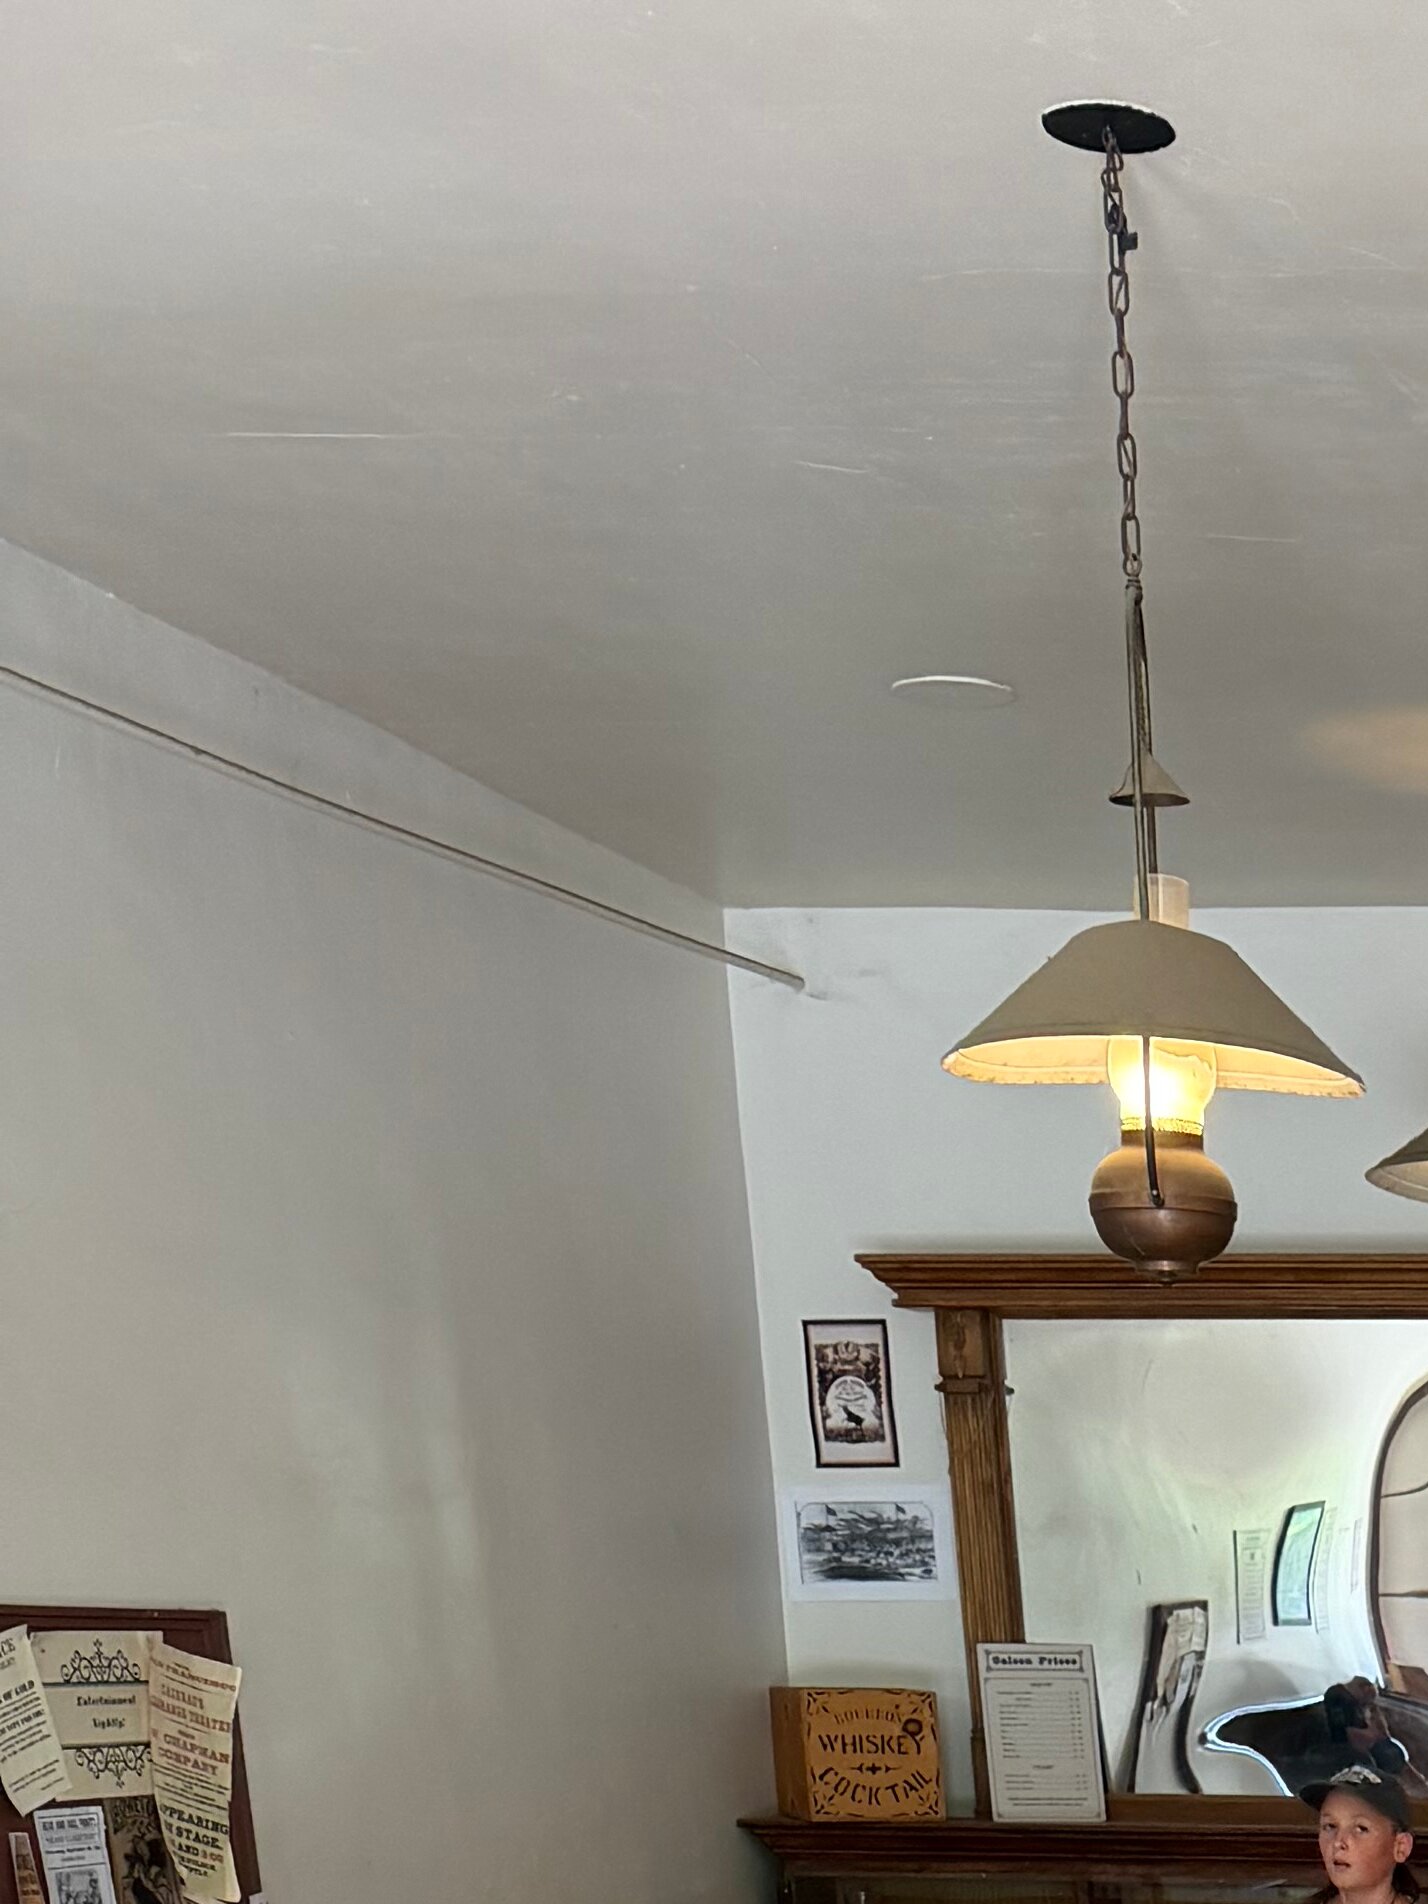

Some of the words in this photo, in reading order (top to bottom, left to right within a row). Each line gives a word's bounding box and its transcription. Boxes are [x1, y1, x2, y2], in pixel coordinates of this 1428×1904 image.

[992, 1655, 1034, 1666] Saloon
[1038, 1655, 1079, 1667] Prices
[818, 1733, 926, 1756] WHISKEY
[819, 1766, 933, 1807] COCKTAIL
